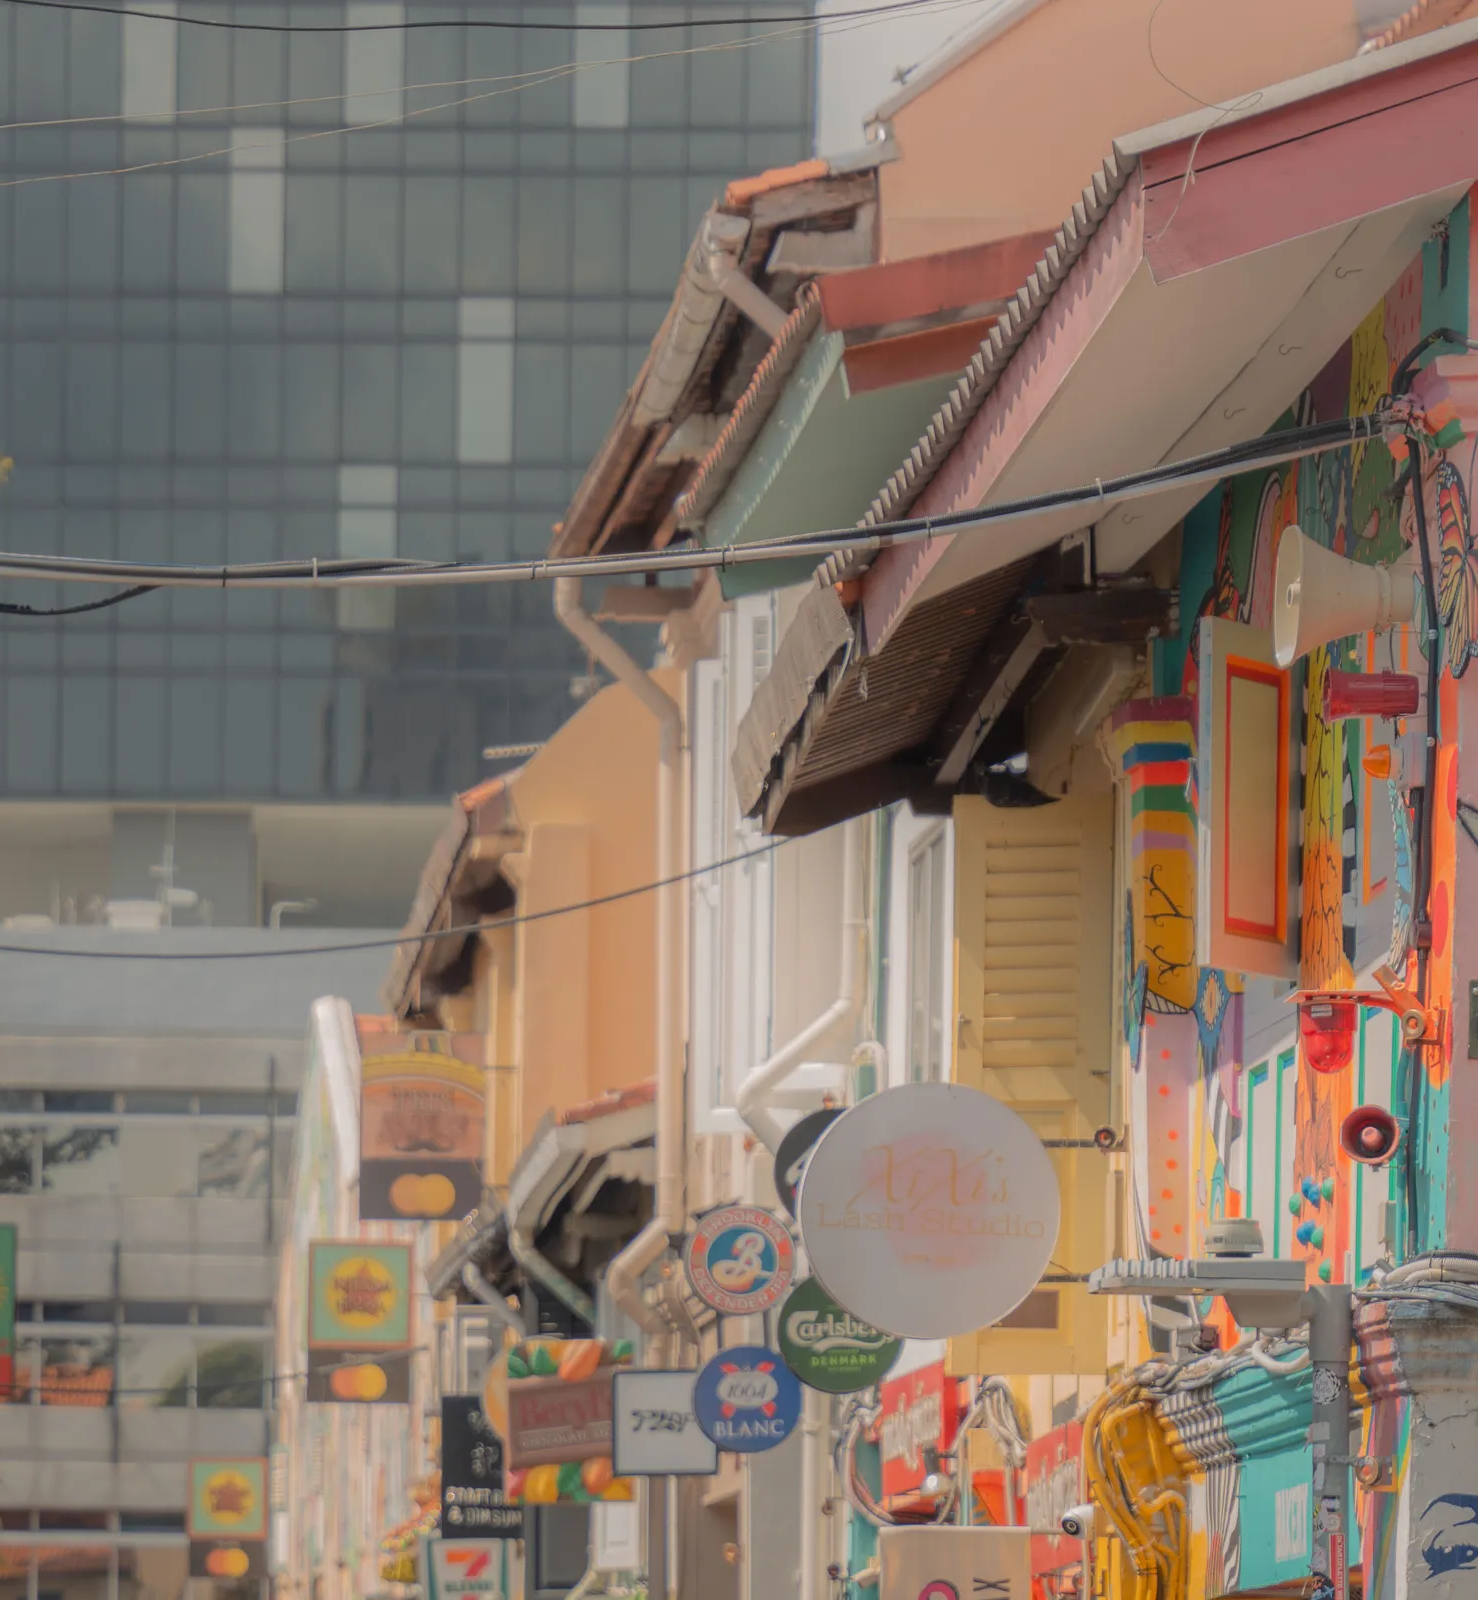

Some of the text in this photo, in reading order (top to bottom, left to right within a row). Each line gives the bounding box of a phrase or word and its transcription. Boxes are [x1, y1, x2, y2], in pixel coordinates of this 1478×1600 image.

[701, 1209, 785, 1242] BROOKLYN
[816, 1202, 1046, 1240] Lash Studio
[693, 1266, 769, 1309] DEFENDER
[811, 1353, 878, 1369] DENMARK
[713, 1418, 785, 1440] BLANC
